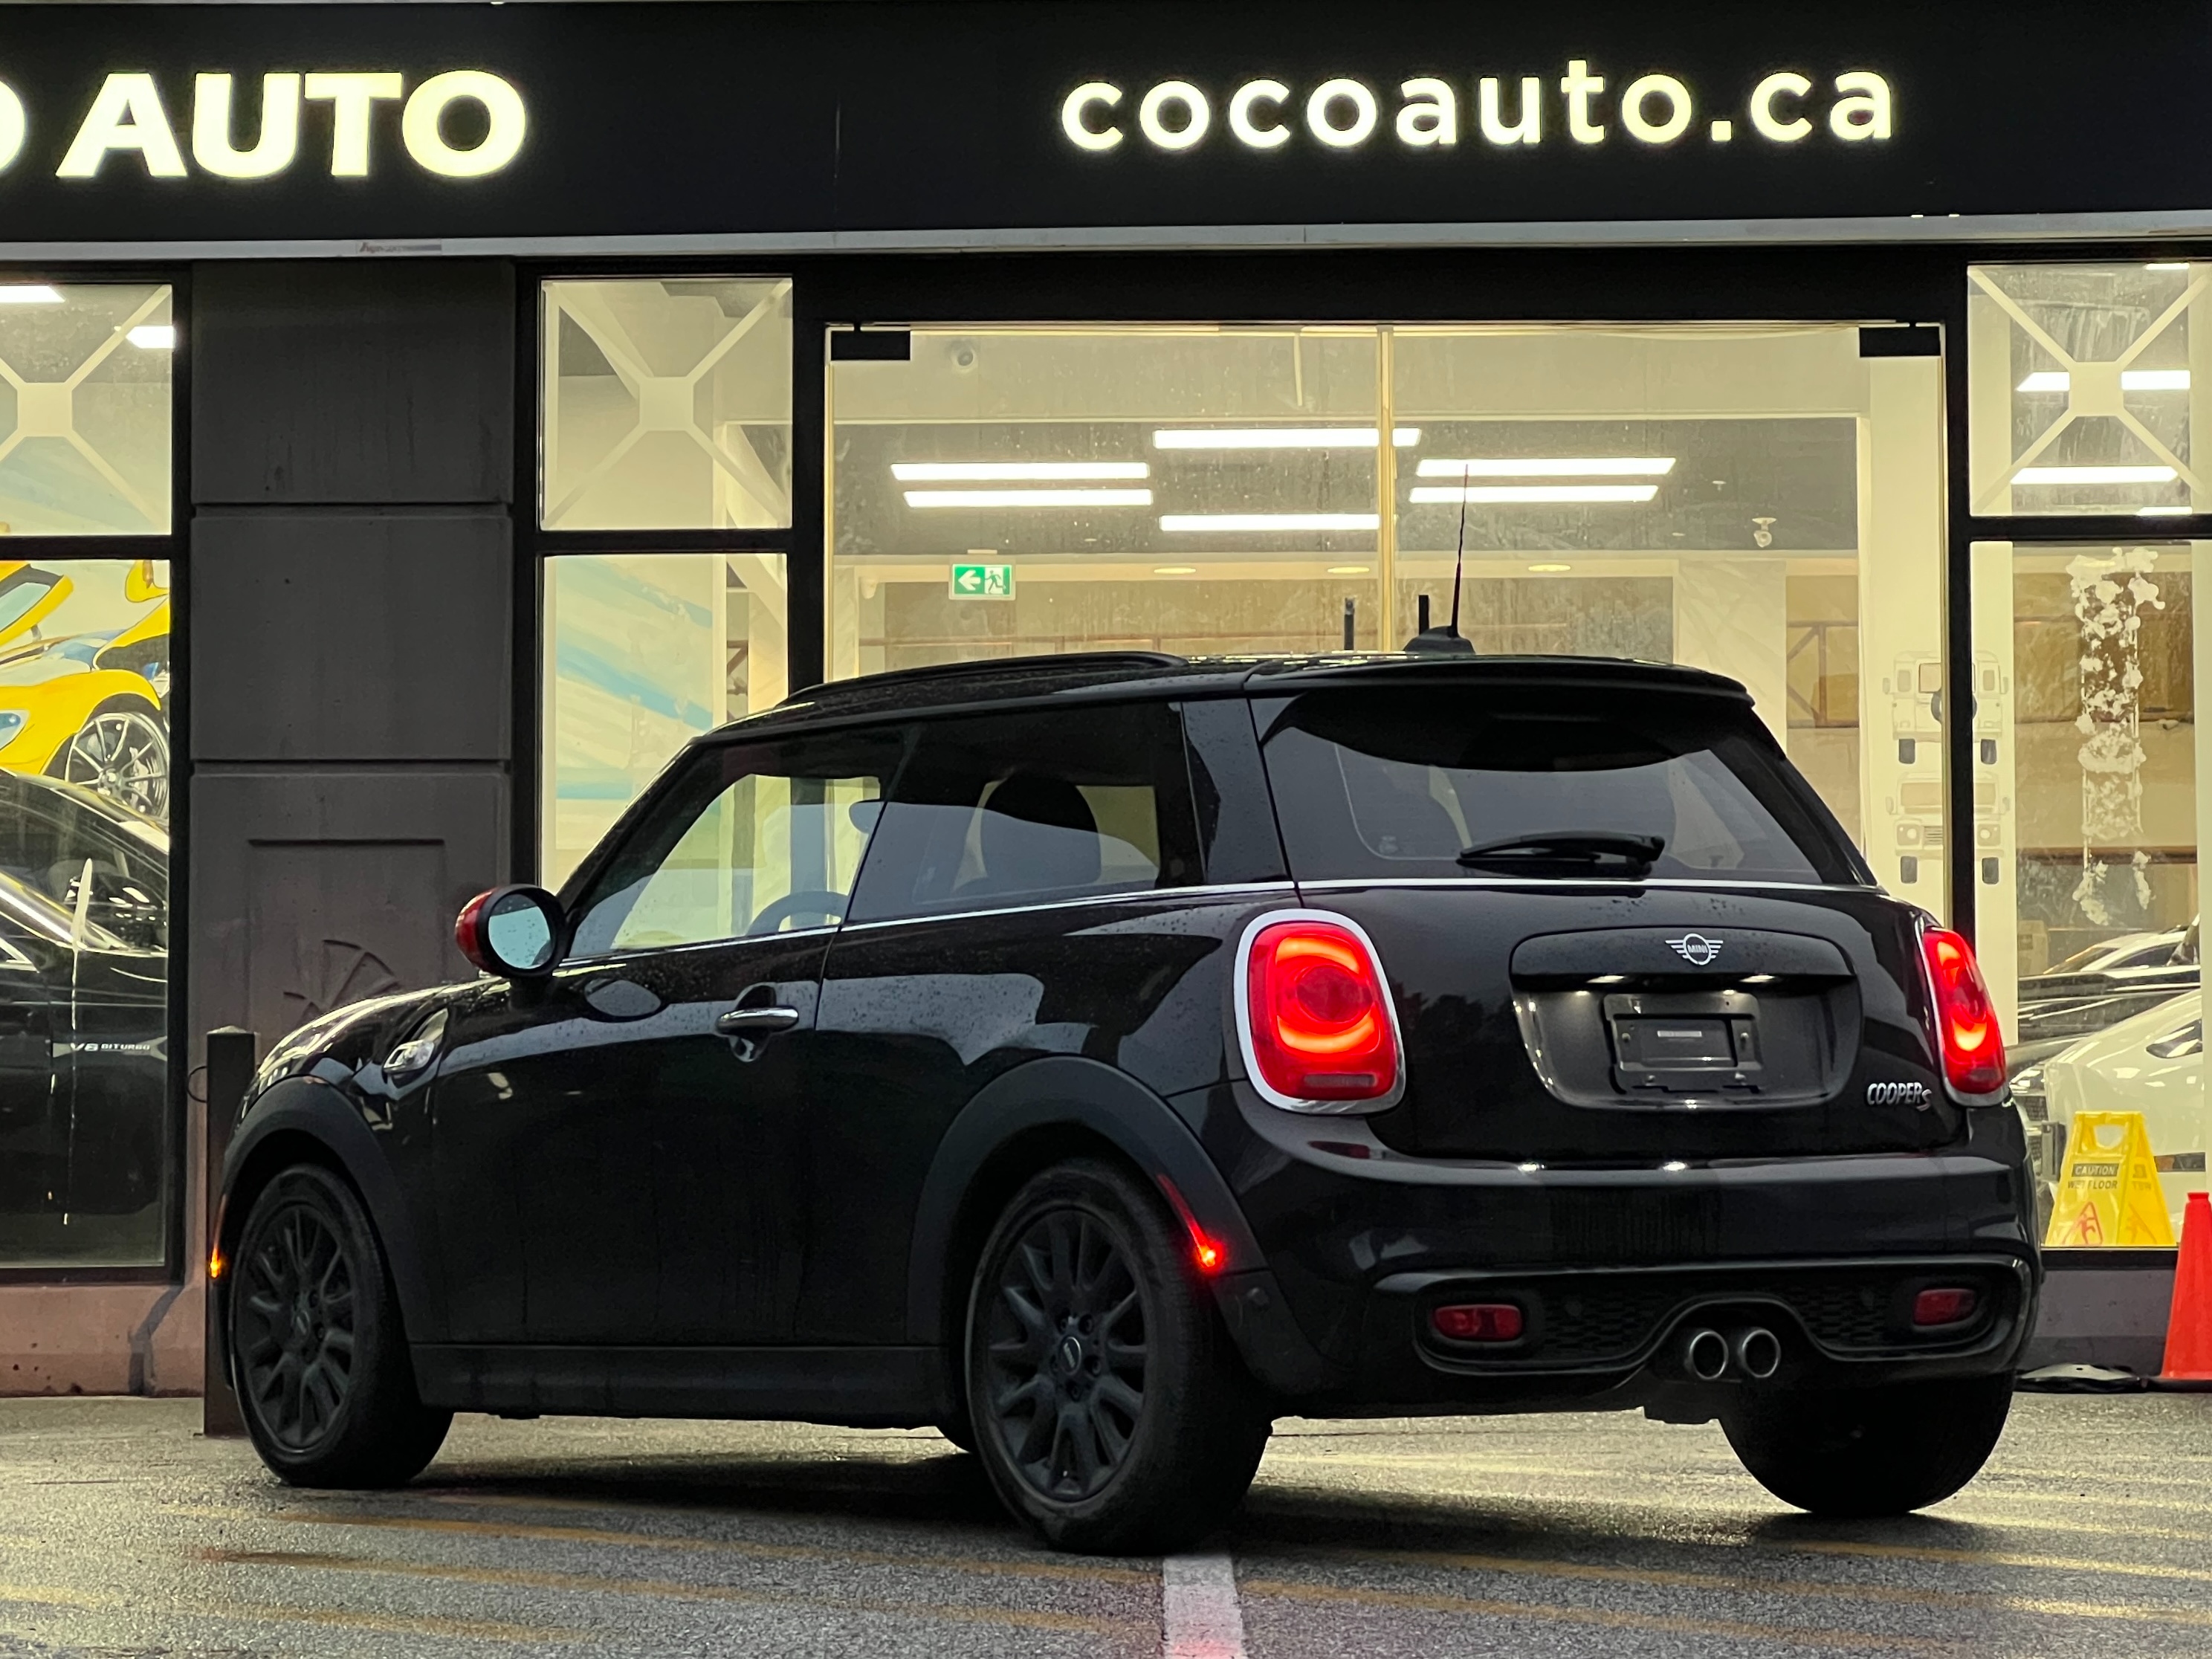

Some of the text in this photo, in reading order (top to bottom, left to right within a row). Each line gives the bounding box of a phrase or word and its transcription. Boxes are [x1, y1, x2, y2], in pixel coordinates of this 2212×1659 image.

[1061, 59, 1892, 152] cocoauto.ca
[56, 70, 527, 179] AUTO
[1687, 944, 1708, 954] MINI
[70, 1042, 98, 1052] V8
[2074, 1165, 2115, 1175] CAUTION
[2087, 1180, 2118, 1189] FLOOR
